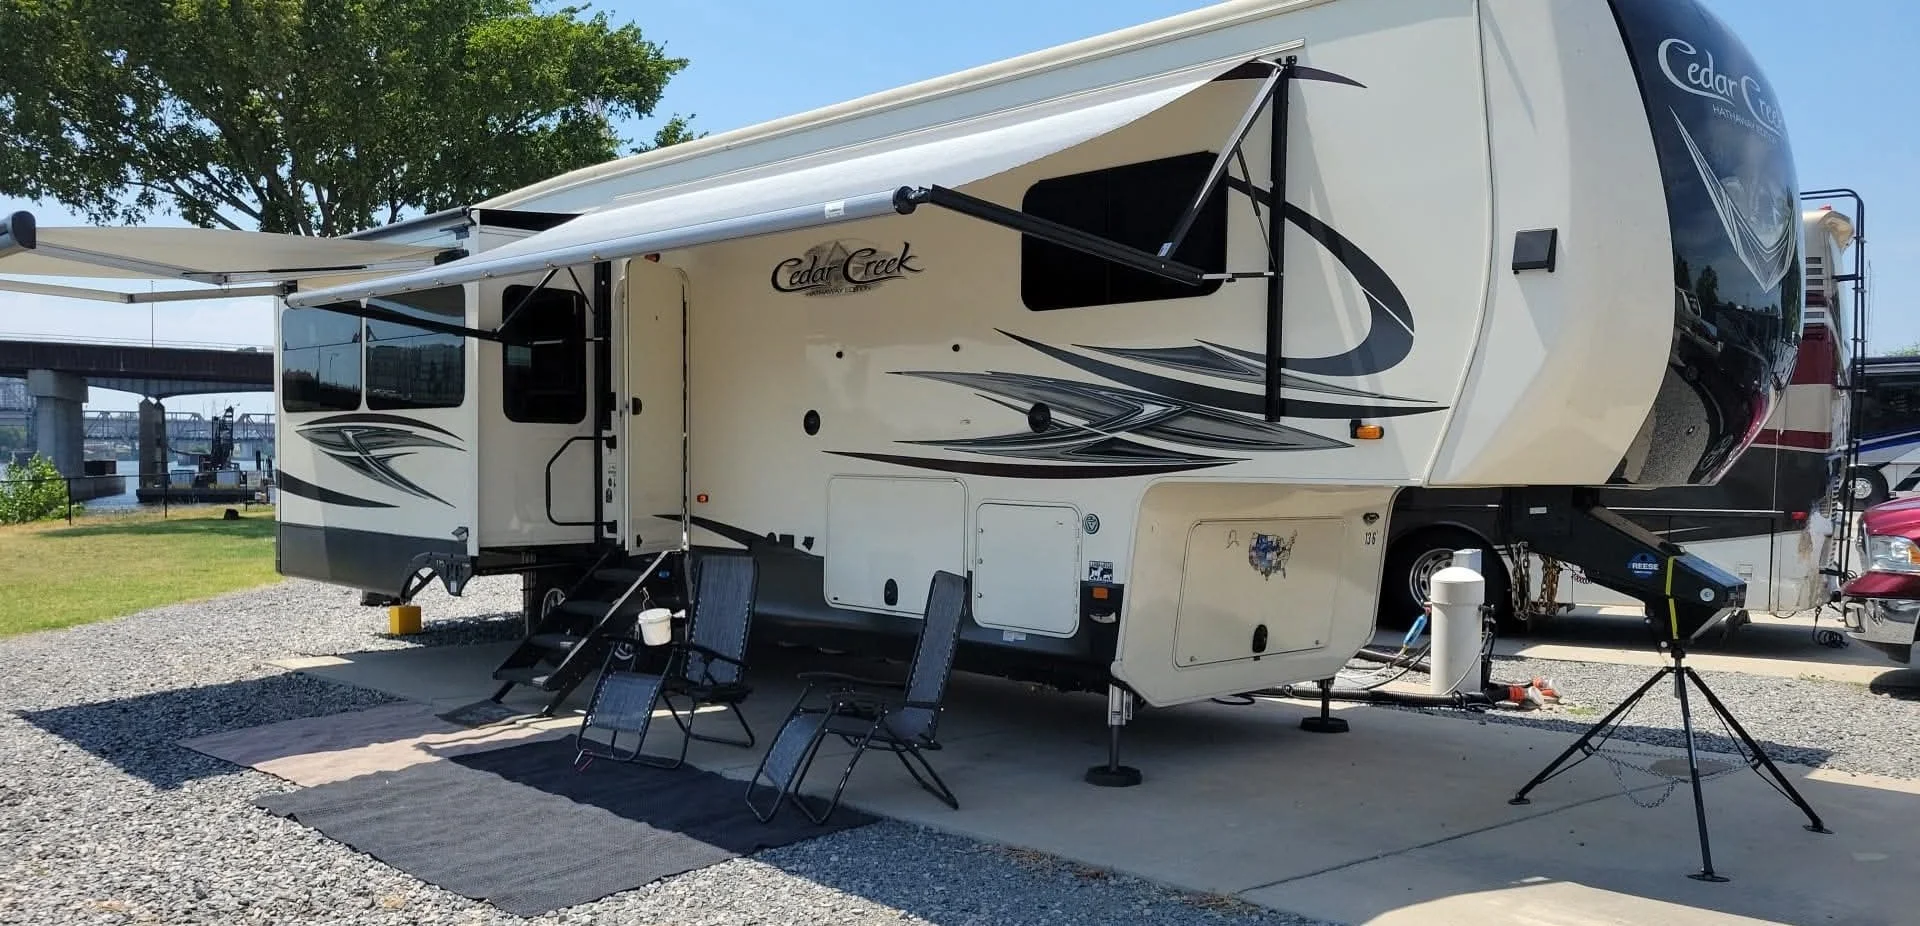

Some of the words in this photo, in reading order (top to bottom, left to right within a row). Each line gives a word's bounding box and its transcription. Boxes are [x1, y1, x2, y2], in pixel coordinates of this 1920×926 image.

[1658, 38, 1738, 107] Cedar
[771, 256, 838, 292] Cedar
[843, 241, 925, 284] Creek
[1632, 562, 1659, 571] REESE
